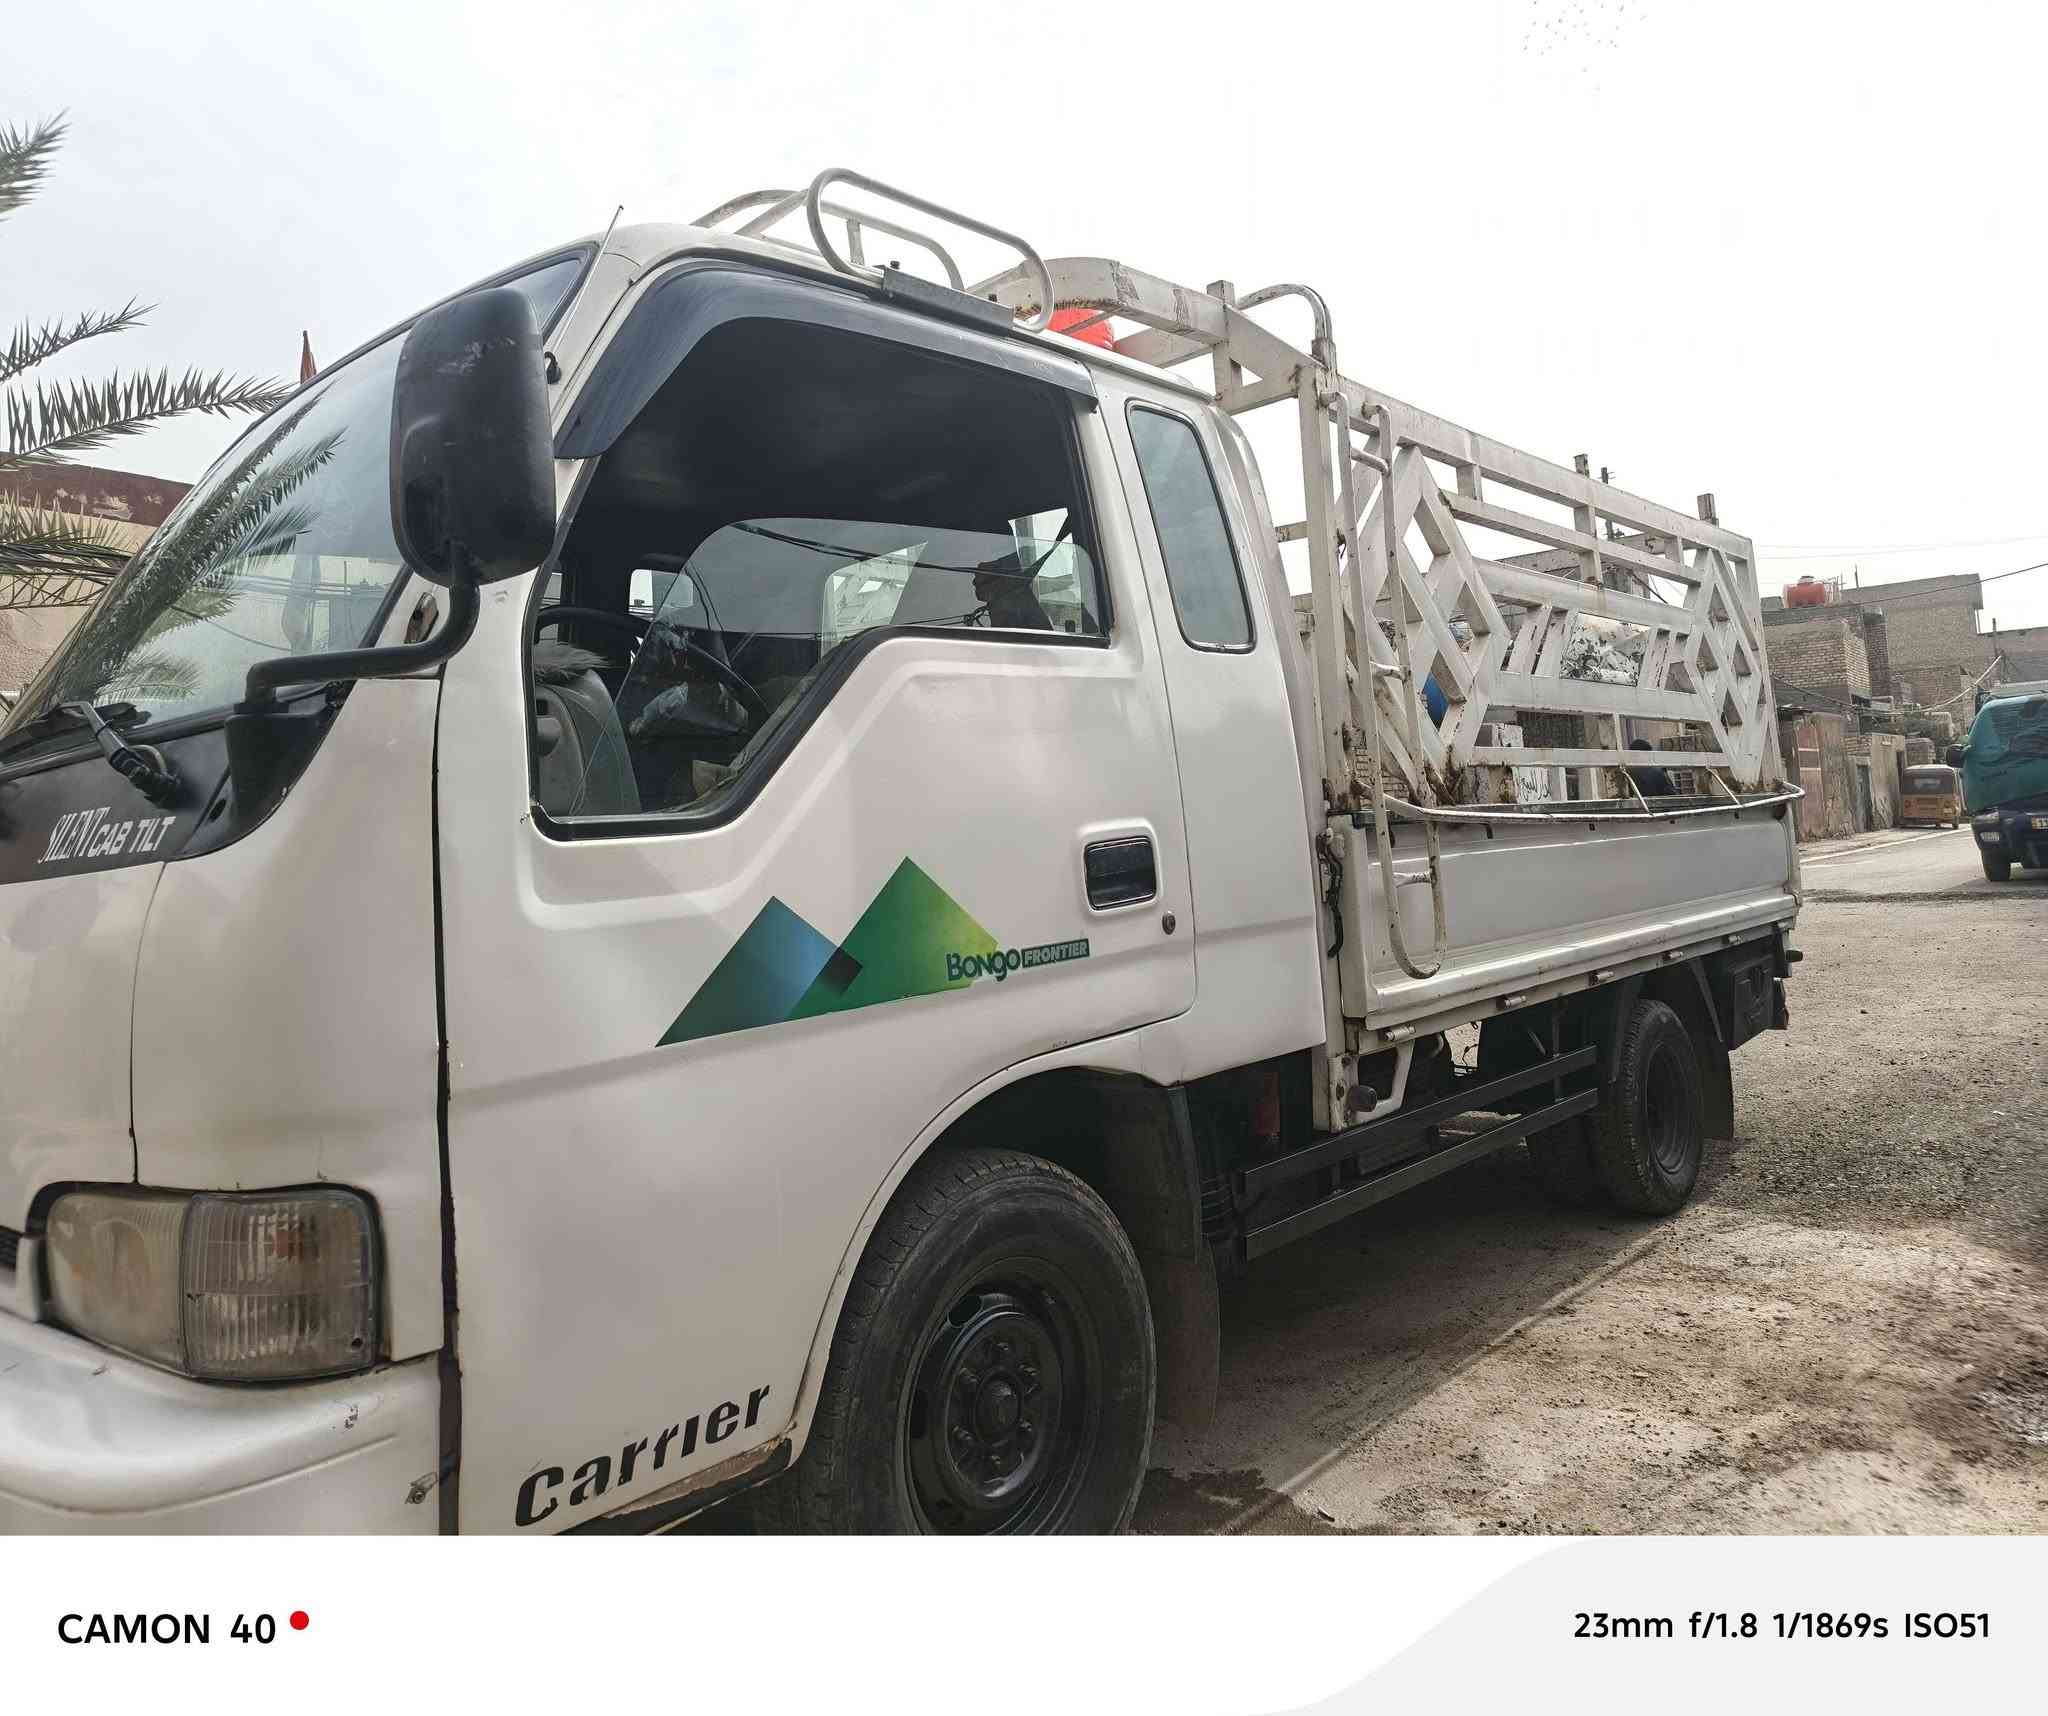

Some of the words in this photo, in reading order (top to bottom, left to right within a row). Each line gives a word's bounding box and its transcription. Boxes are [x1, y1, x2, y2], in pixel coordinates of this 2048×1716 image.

[37, 806, 112, 864] SILENT
[88, 821, 134, 857] CAB
[129, 816, 177, 853] TILT
[1023, 941, 1088, 966] FRONTIER
